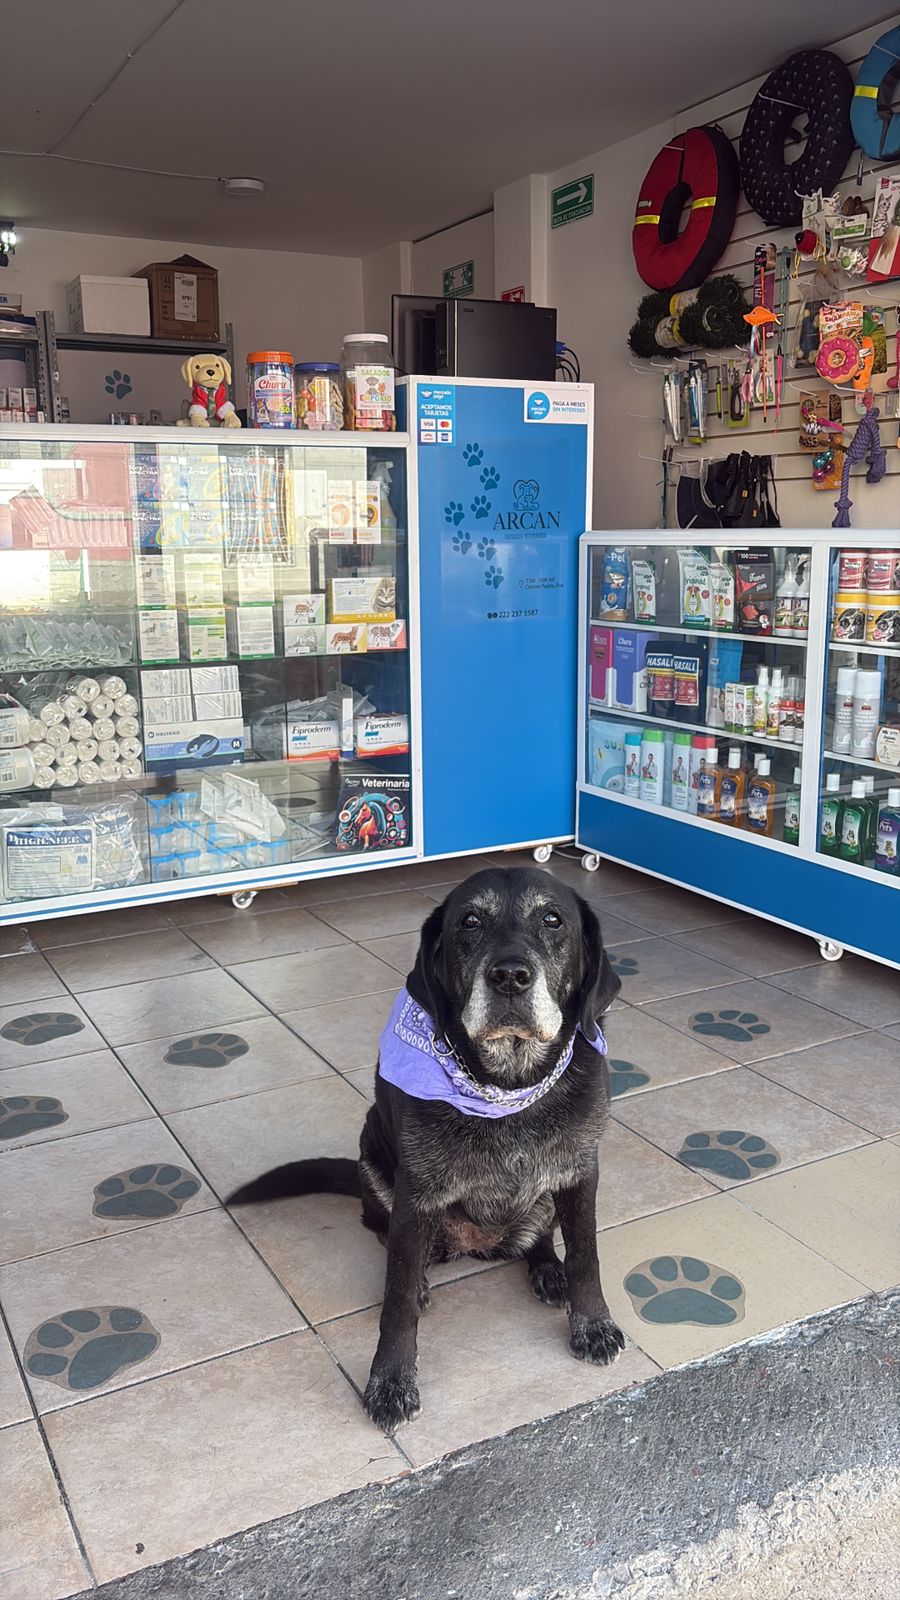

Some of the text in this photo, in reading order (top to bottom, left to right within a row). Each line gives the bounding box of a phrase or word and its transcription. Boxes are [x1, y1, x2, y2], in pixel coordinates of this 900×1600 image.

[361, 369, 391, 377] SALADOS
[258, 379, 287, 389] Churu
[493, 511, 560, 530] ARCAN
[292, 725, 331, 736] Fiproderm
[365, 721, 402, 731] Fiproderm
[362, 778, 410, 788] Veterinaria
[880, 821, 893, 832] Pets
